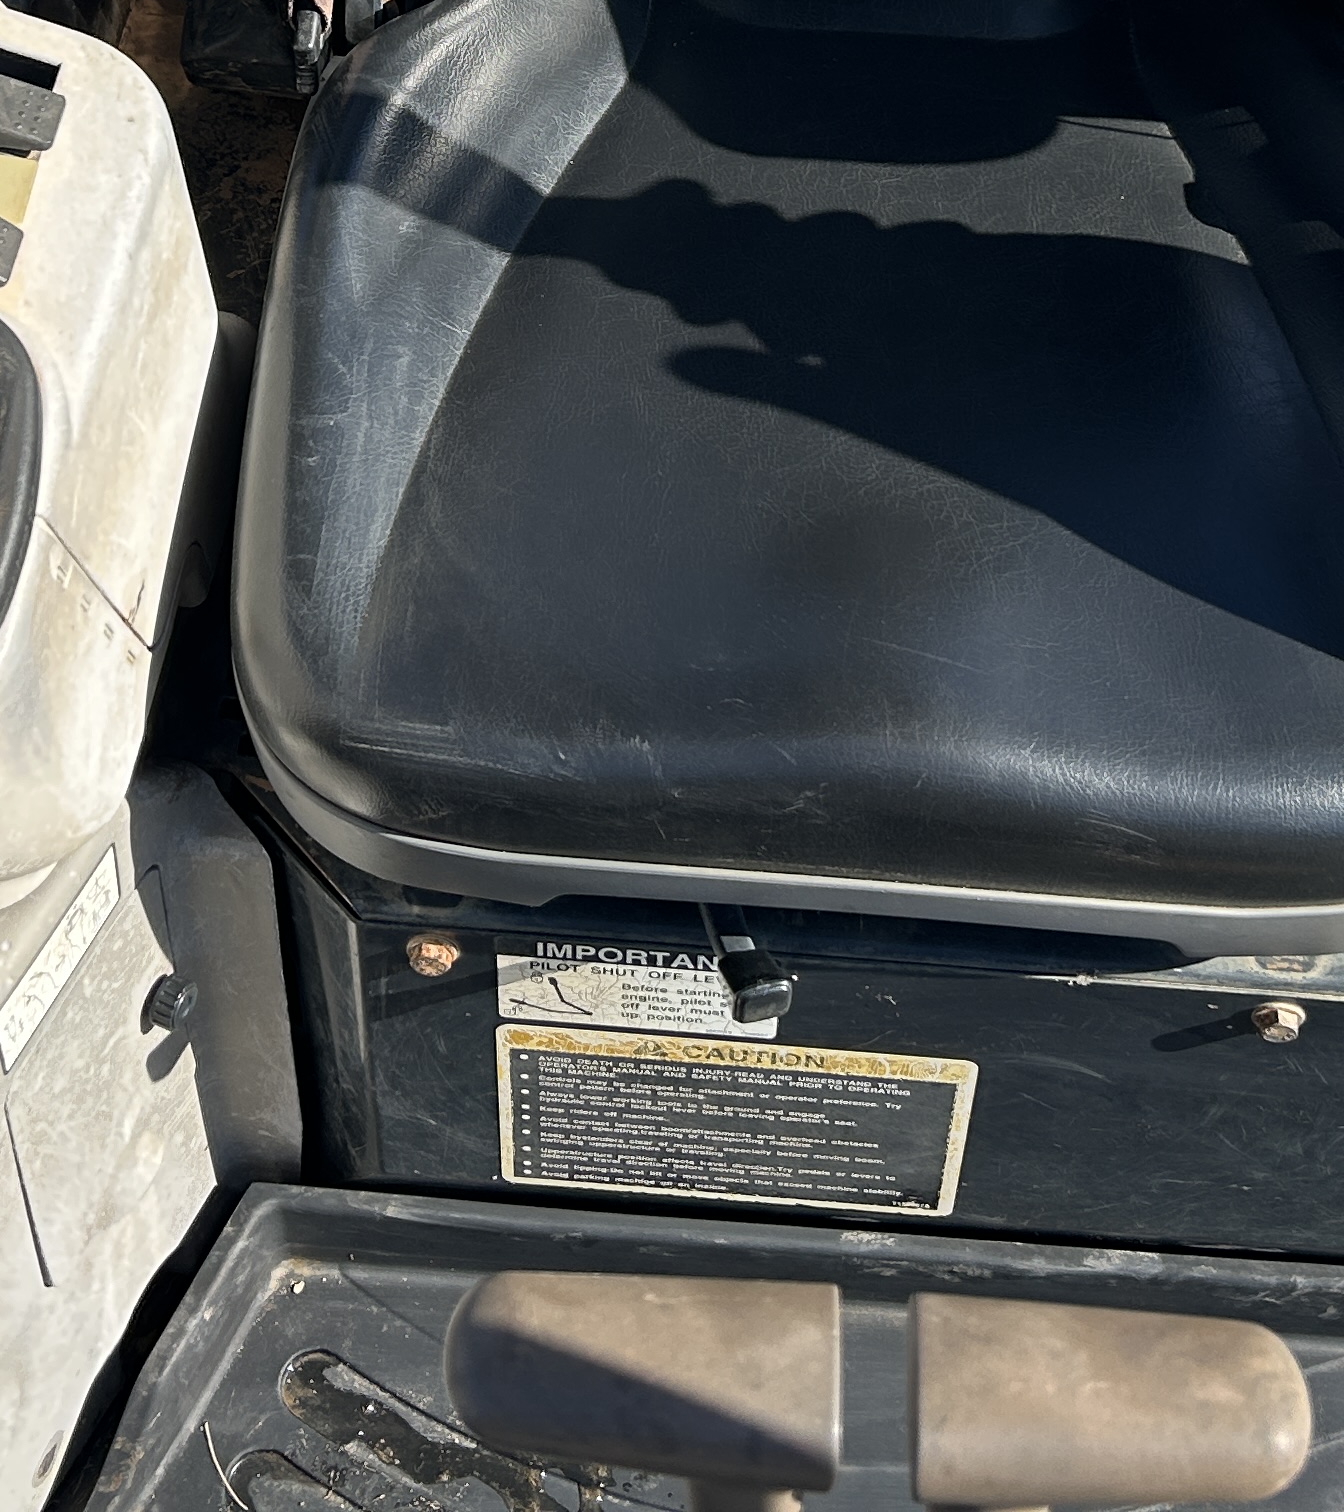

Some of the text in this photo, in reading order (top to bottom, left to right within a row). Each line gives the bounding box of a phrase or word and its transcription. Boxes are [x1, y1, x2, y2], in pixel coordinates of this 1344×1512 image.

[536, 941, 719, 973] IMPORTAN
[529, 960, 580, 974] PILOT
[590, 965, 638, 979] SHUT
[648, 970, 685, 982] OFF
[621, 982, 668, 995] Before
[620, 1002, 725, 1017] off lever must
[680, 998, 712, 1007] pilot
[620, 1011, 704, 1024] up position
[682, 1044, 826, 1070] CAUTION
